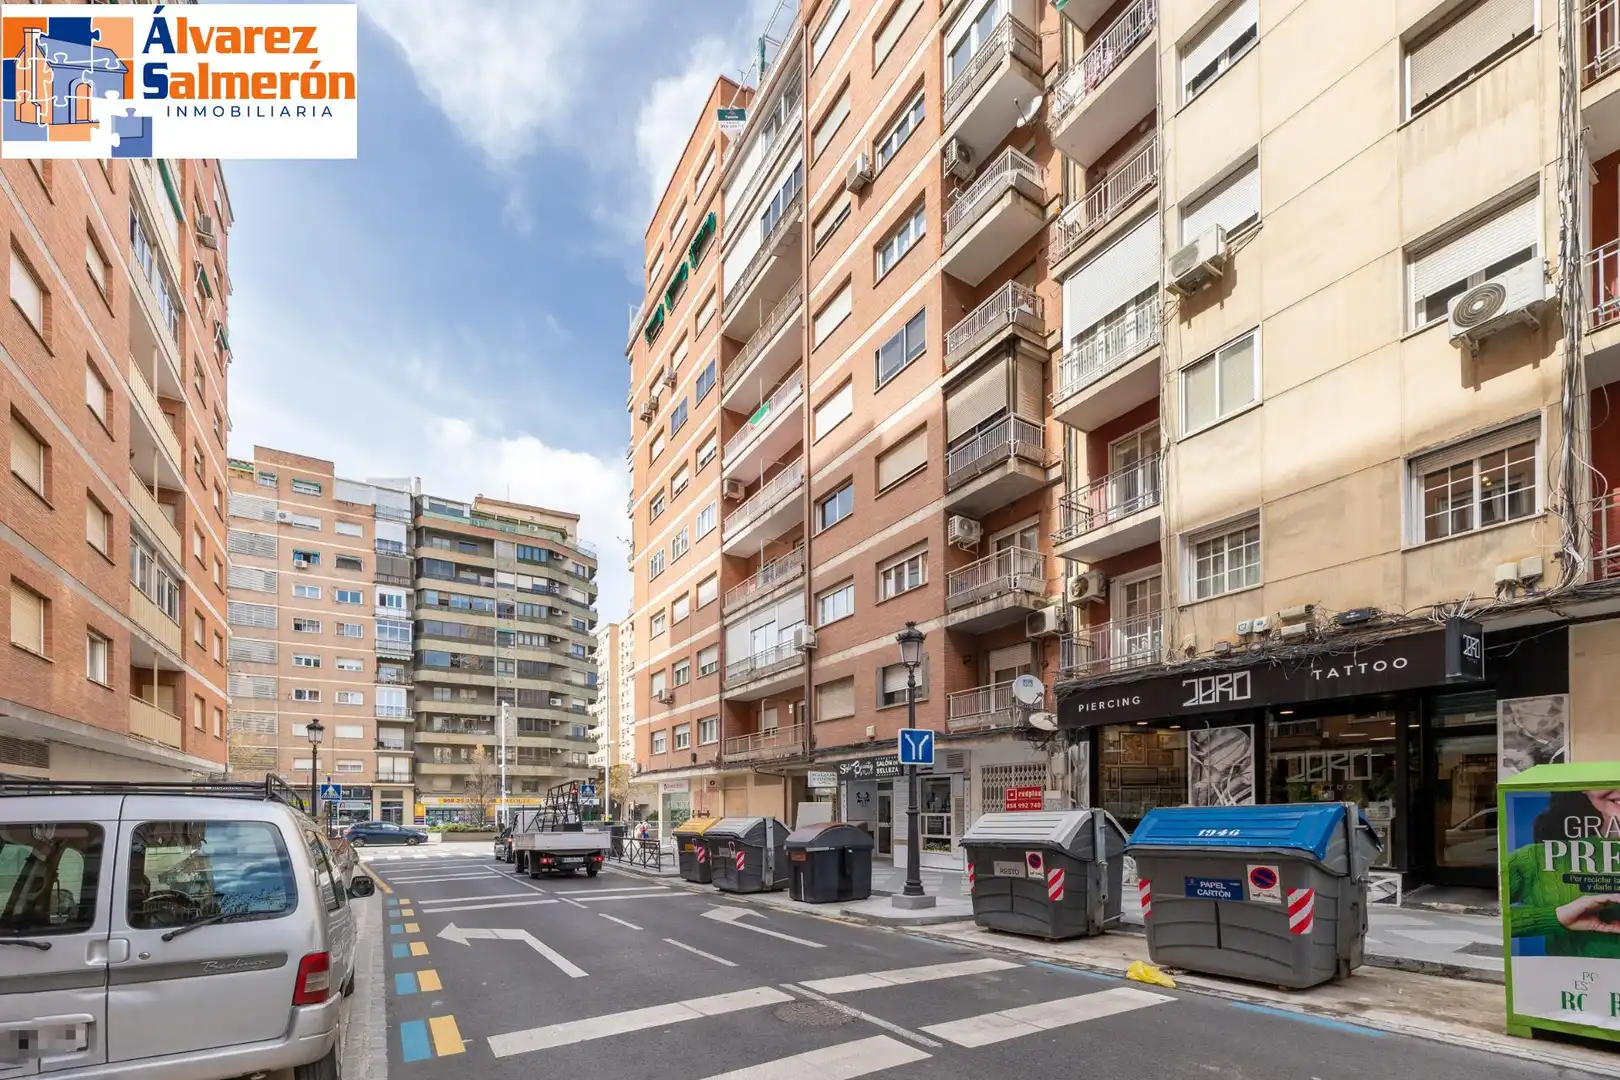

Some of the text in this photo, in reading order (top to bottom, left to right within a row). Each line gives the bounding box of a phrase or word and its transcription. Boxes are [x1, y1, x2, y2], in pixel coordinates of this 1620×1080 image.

[1078, 695, 1141, 712] PIERCING
[1313, 657, 1408, 680] TATTOO
[876, 766, 899, 774] BELLEZA
[1198, 828, 1241, 837] 1946
[1000, 867, 1019, 875] RESTO
[1200, 880, 1227, 890] PAPEL
[1196, 887, 1231, 898] CARTÓN
